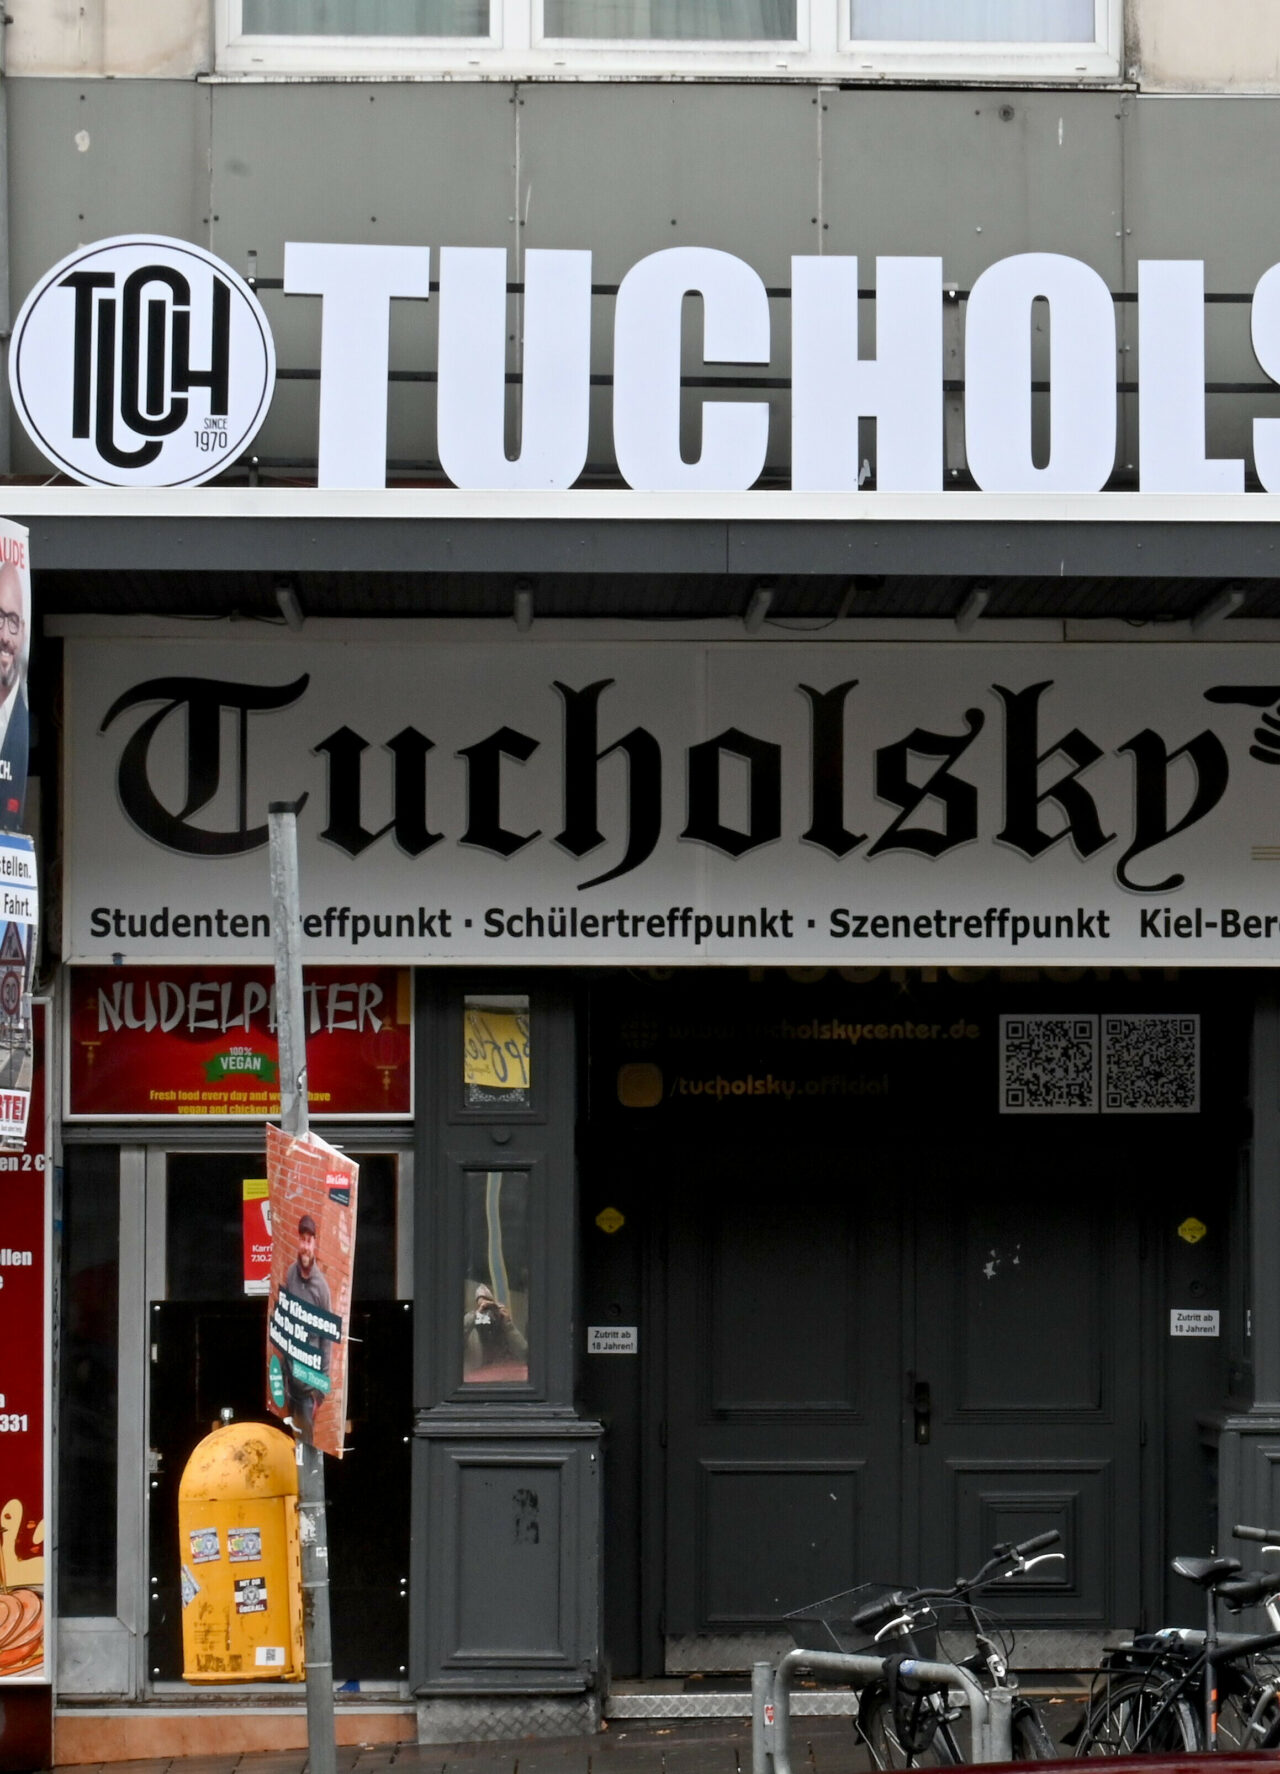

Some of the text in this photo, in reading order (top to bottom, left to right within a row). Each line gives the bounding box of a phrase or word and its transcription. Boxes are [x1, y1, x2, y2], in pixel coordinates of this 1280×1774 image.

[203, 418, 228, 430] SINCE
[193, 430, 228, 453] 1970
[99, 672, 1230, 894] Tucholsky
[3, 893, 33, 918] Fahrt.
[483, 907, 794, 946] Schülertreffpunkt
[829, 907, 1111, 946] Szenetreffpunkt
[229, 1046, 253, 1057] 100%
[220, 1056, 262, 1071] VEGAN
[150, 1090, 176, 1101] Fresh
[178, 1090, 200, 1101] food
[202, 1091, 229, 1103] every
[230, 1090, 248, 1103] day
[250, 1091, 268, 1102] and
[178, 1104, 207, 1114] vegan
[209, 1104, 227, 1114] and
[229, 1104, 268, 1114] chicken
[22, 1154, 32, 1172] 2
[34, 1154, 46, 1172] €
[0, 1248, 33, 1266] llen
[289, 1299, 341, 1341] Kitaessen,
[1177, 1313, 1213, 1322] Zutritt ab
[294, 1323, 309, 1343] Dir
[594, 1330, 631, 1339] Zutritt ab
[1175, 1324, 1216, 1333] 18 Jahren!
[592, 1341, 634, 1351] 18 Jahren!
[288, 1338, 322, 1371] kannst!
